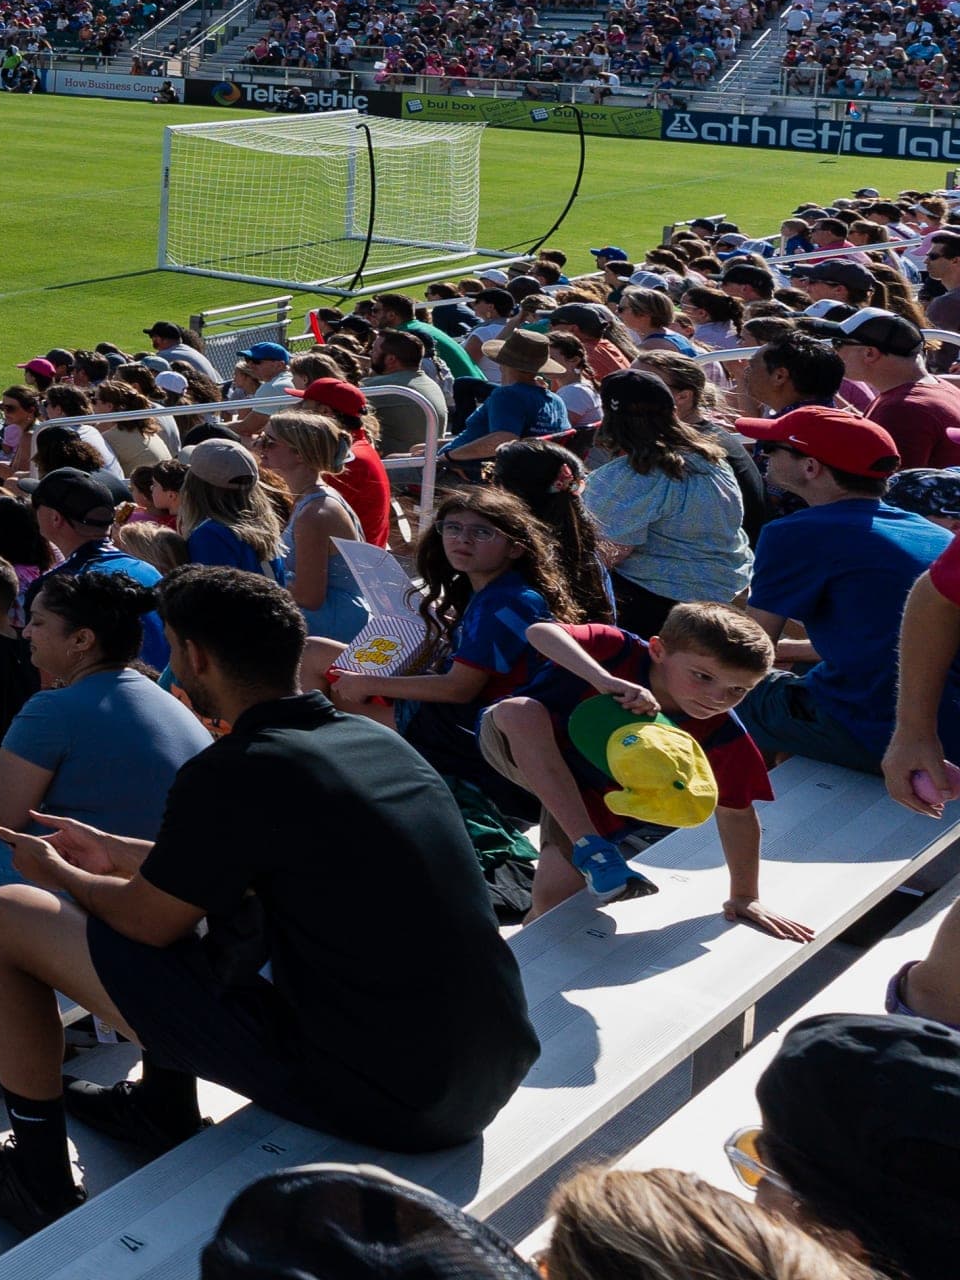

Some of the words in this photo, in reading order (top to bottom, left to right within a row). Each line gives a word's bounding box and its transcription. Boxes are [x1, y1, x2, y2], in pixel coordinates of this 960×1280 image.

[65, 78, 87, 88] How
[88, 79, 131, 91] Business
[427, 99, 449, 110] bul
[452, 101, 477, 111] box
[701, 116, 884, 154] athletic
[261, 1142, 287, 1156] 16
[119, 1235, 145, 1252] 17
